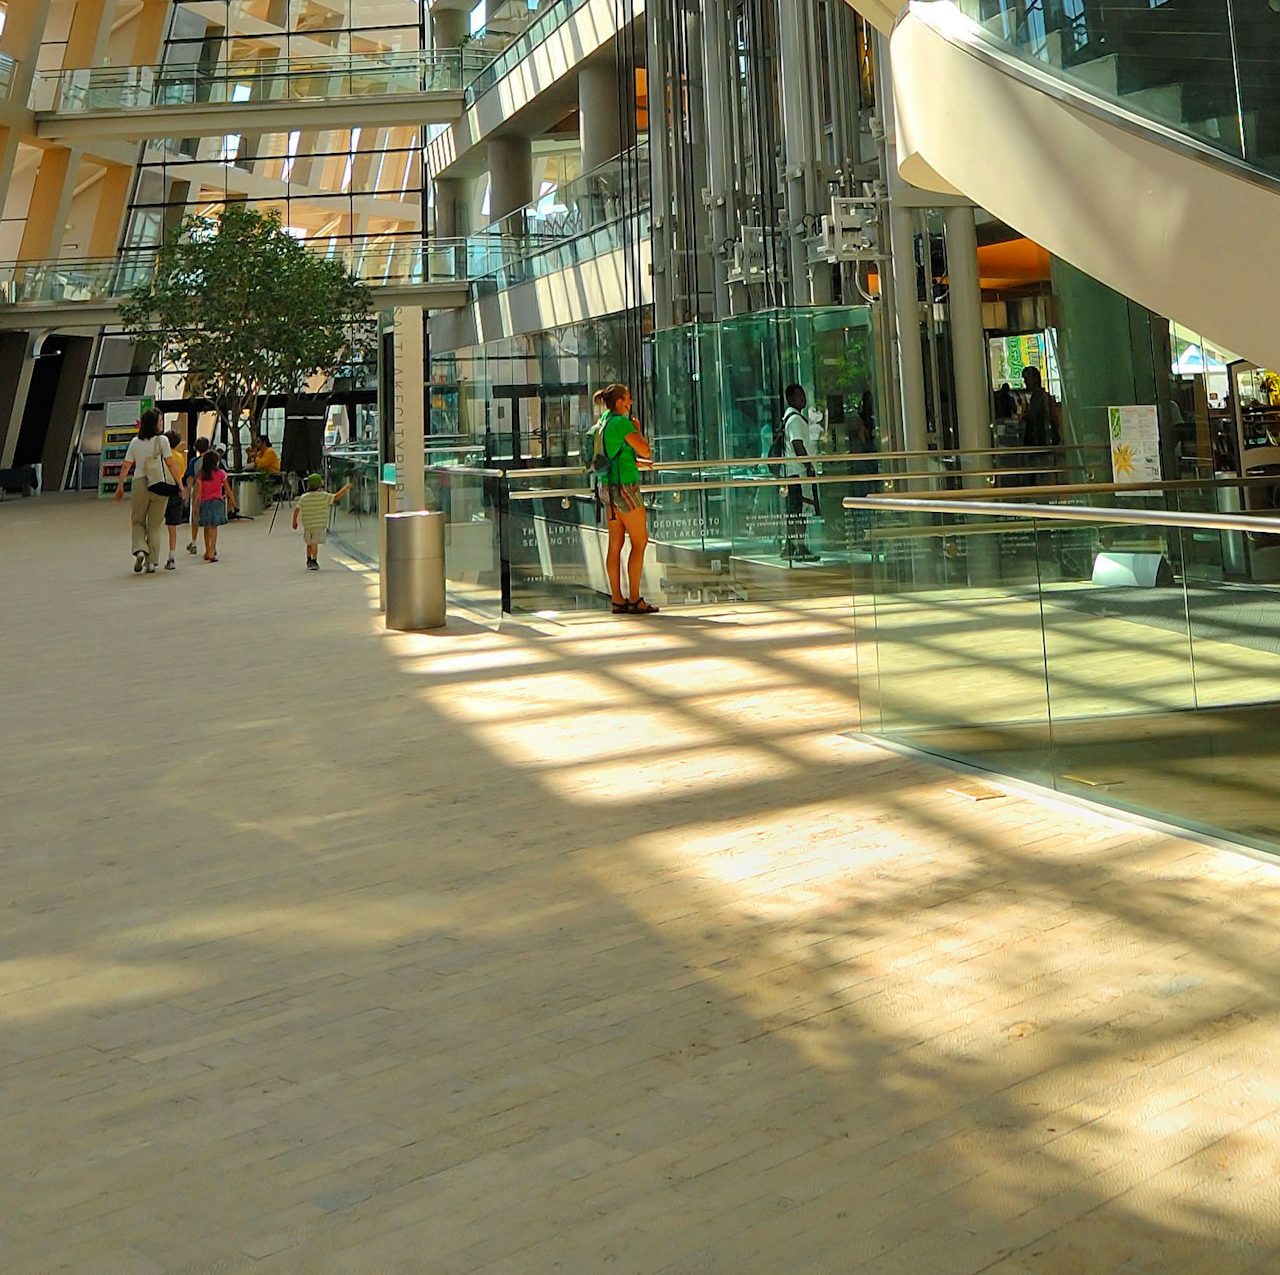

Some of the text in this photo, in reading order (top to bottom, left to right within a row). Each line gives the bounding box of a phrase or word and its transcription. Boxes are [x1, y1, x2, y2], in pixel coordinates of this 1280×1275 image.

[653, 518, 705, 529] DEDICATED
[708, 517, 720, 526] TO
[674, 529, 697, 539] LAKE
[700, 528, 720, 537] CITY
